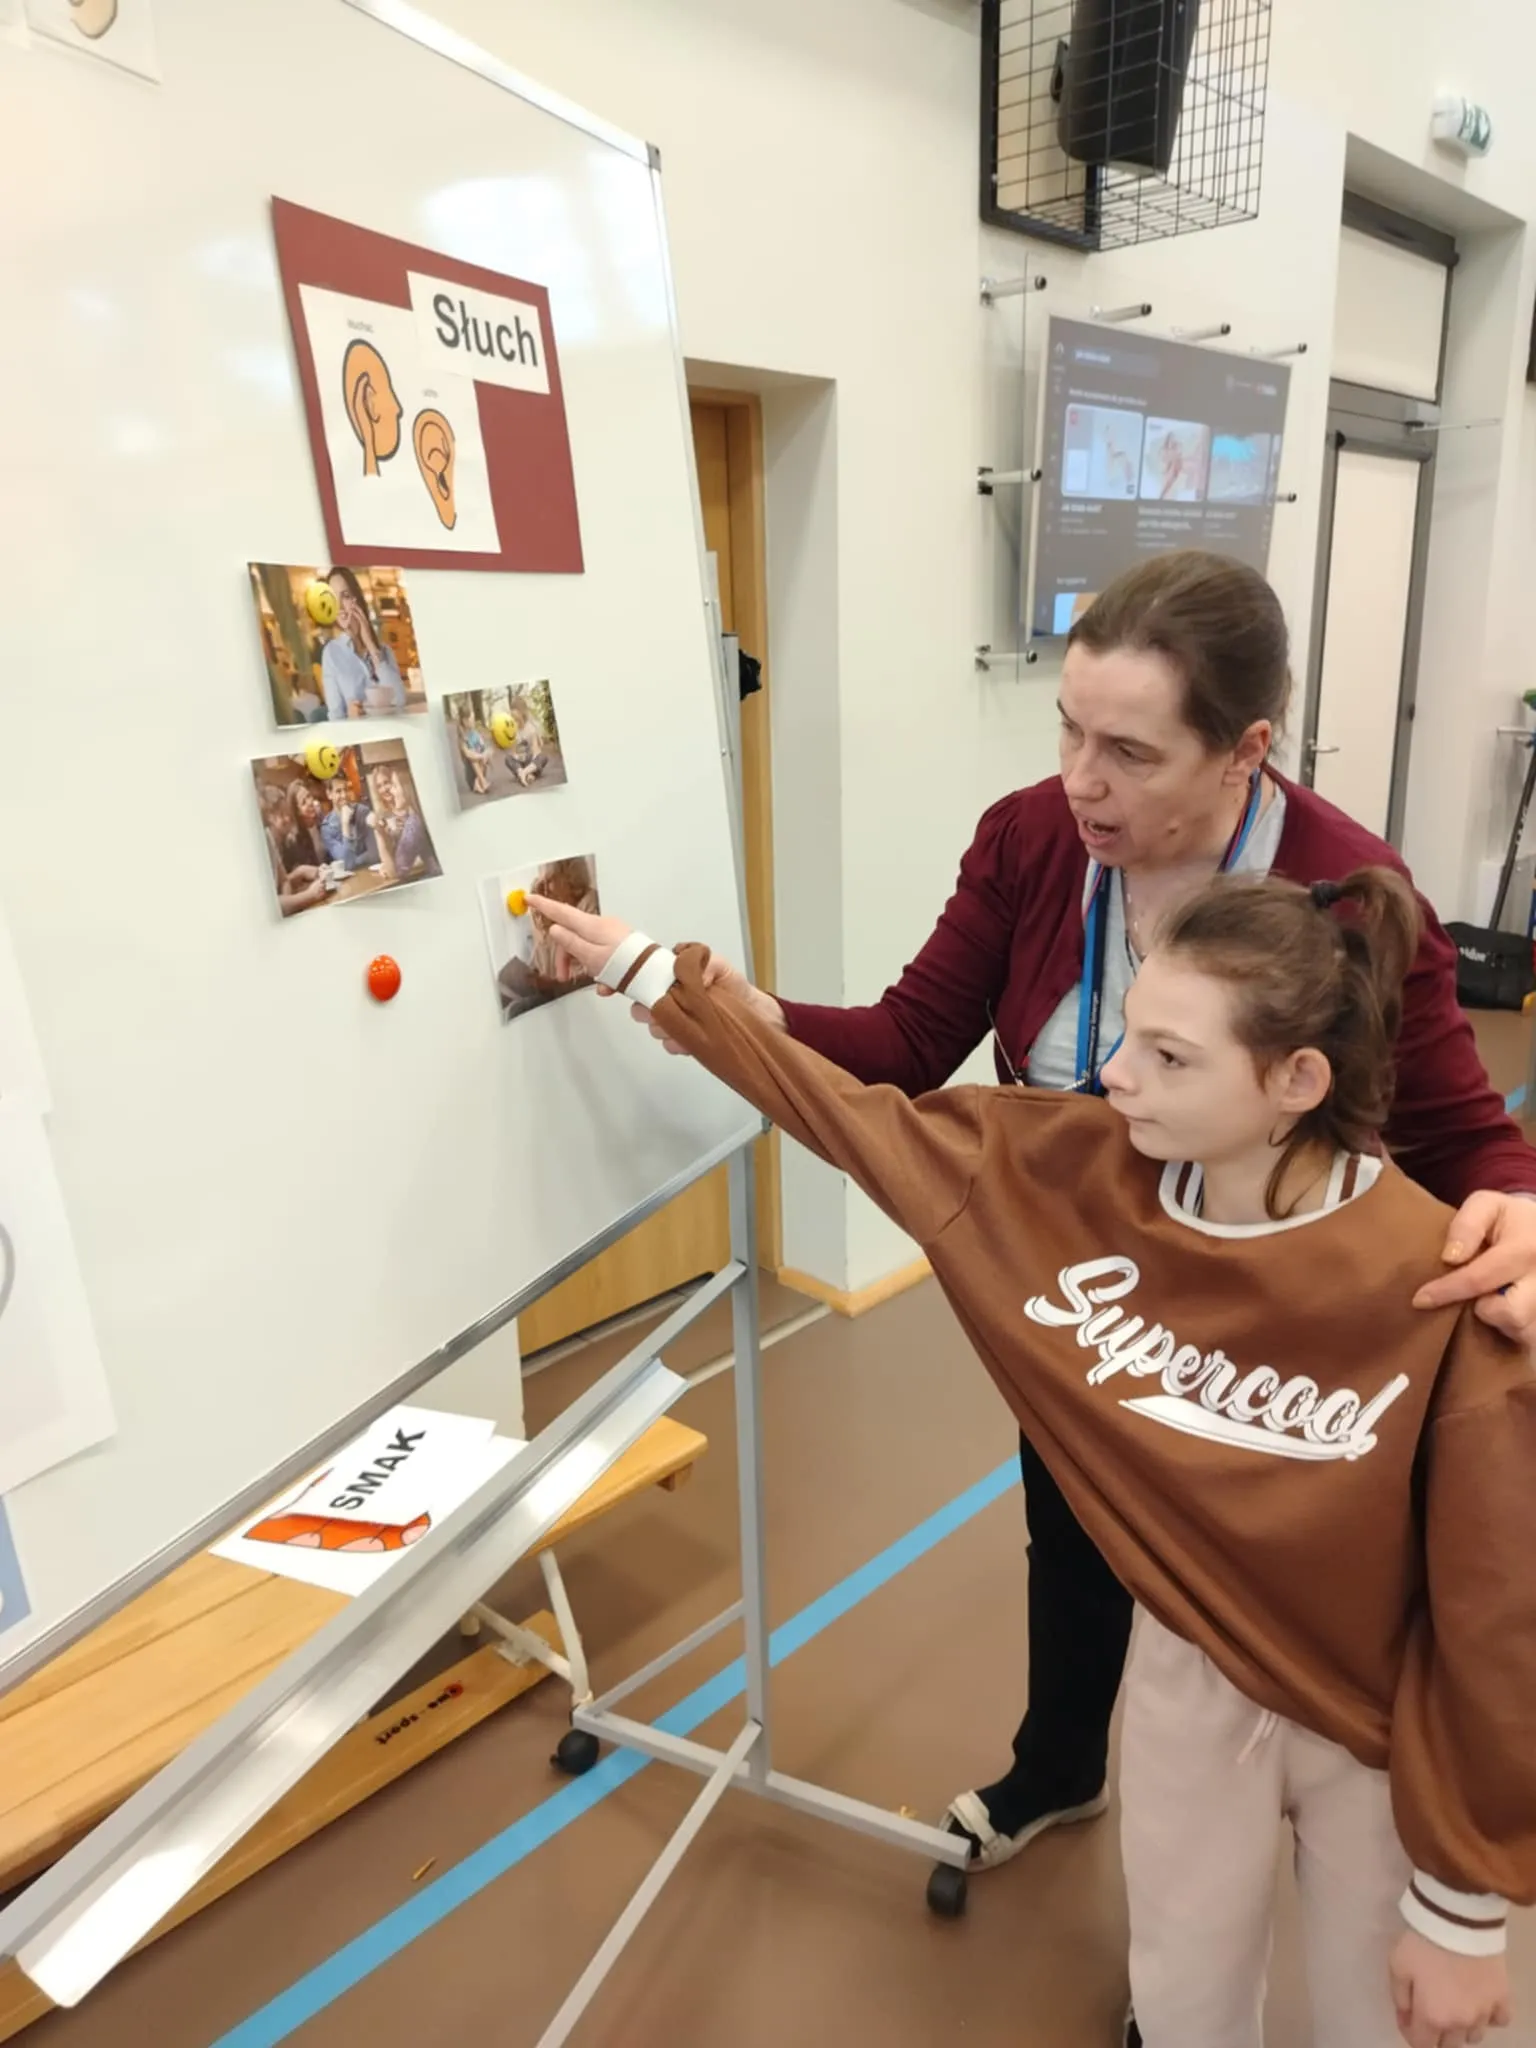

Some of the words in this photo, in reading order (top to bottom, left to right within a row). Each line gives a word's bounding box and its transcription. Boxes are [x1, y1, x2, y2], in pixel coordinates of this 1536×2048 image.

[433, 293, 538, 367] Słuch
[1023, 1254, 1410, 1461] Supercool
[328, 1427, 427, 1511] SMAK
